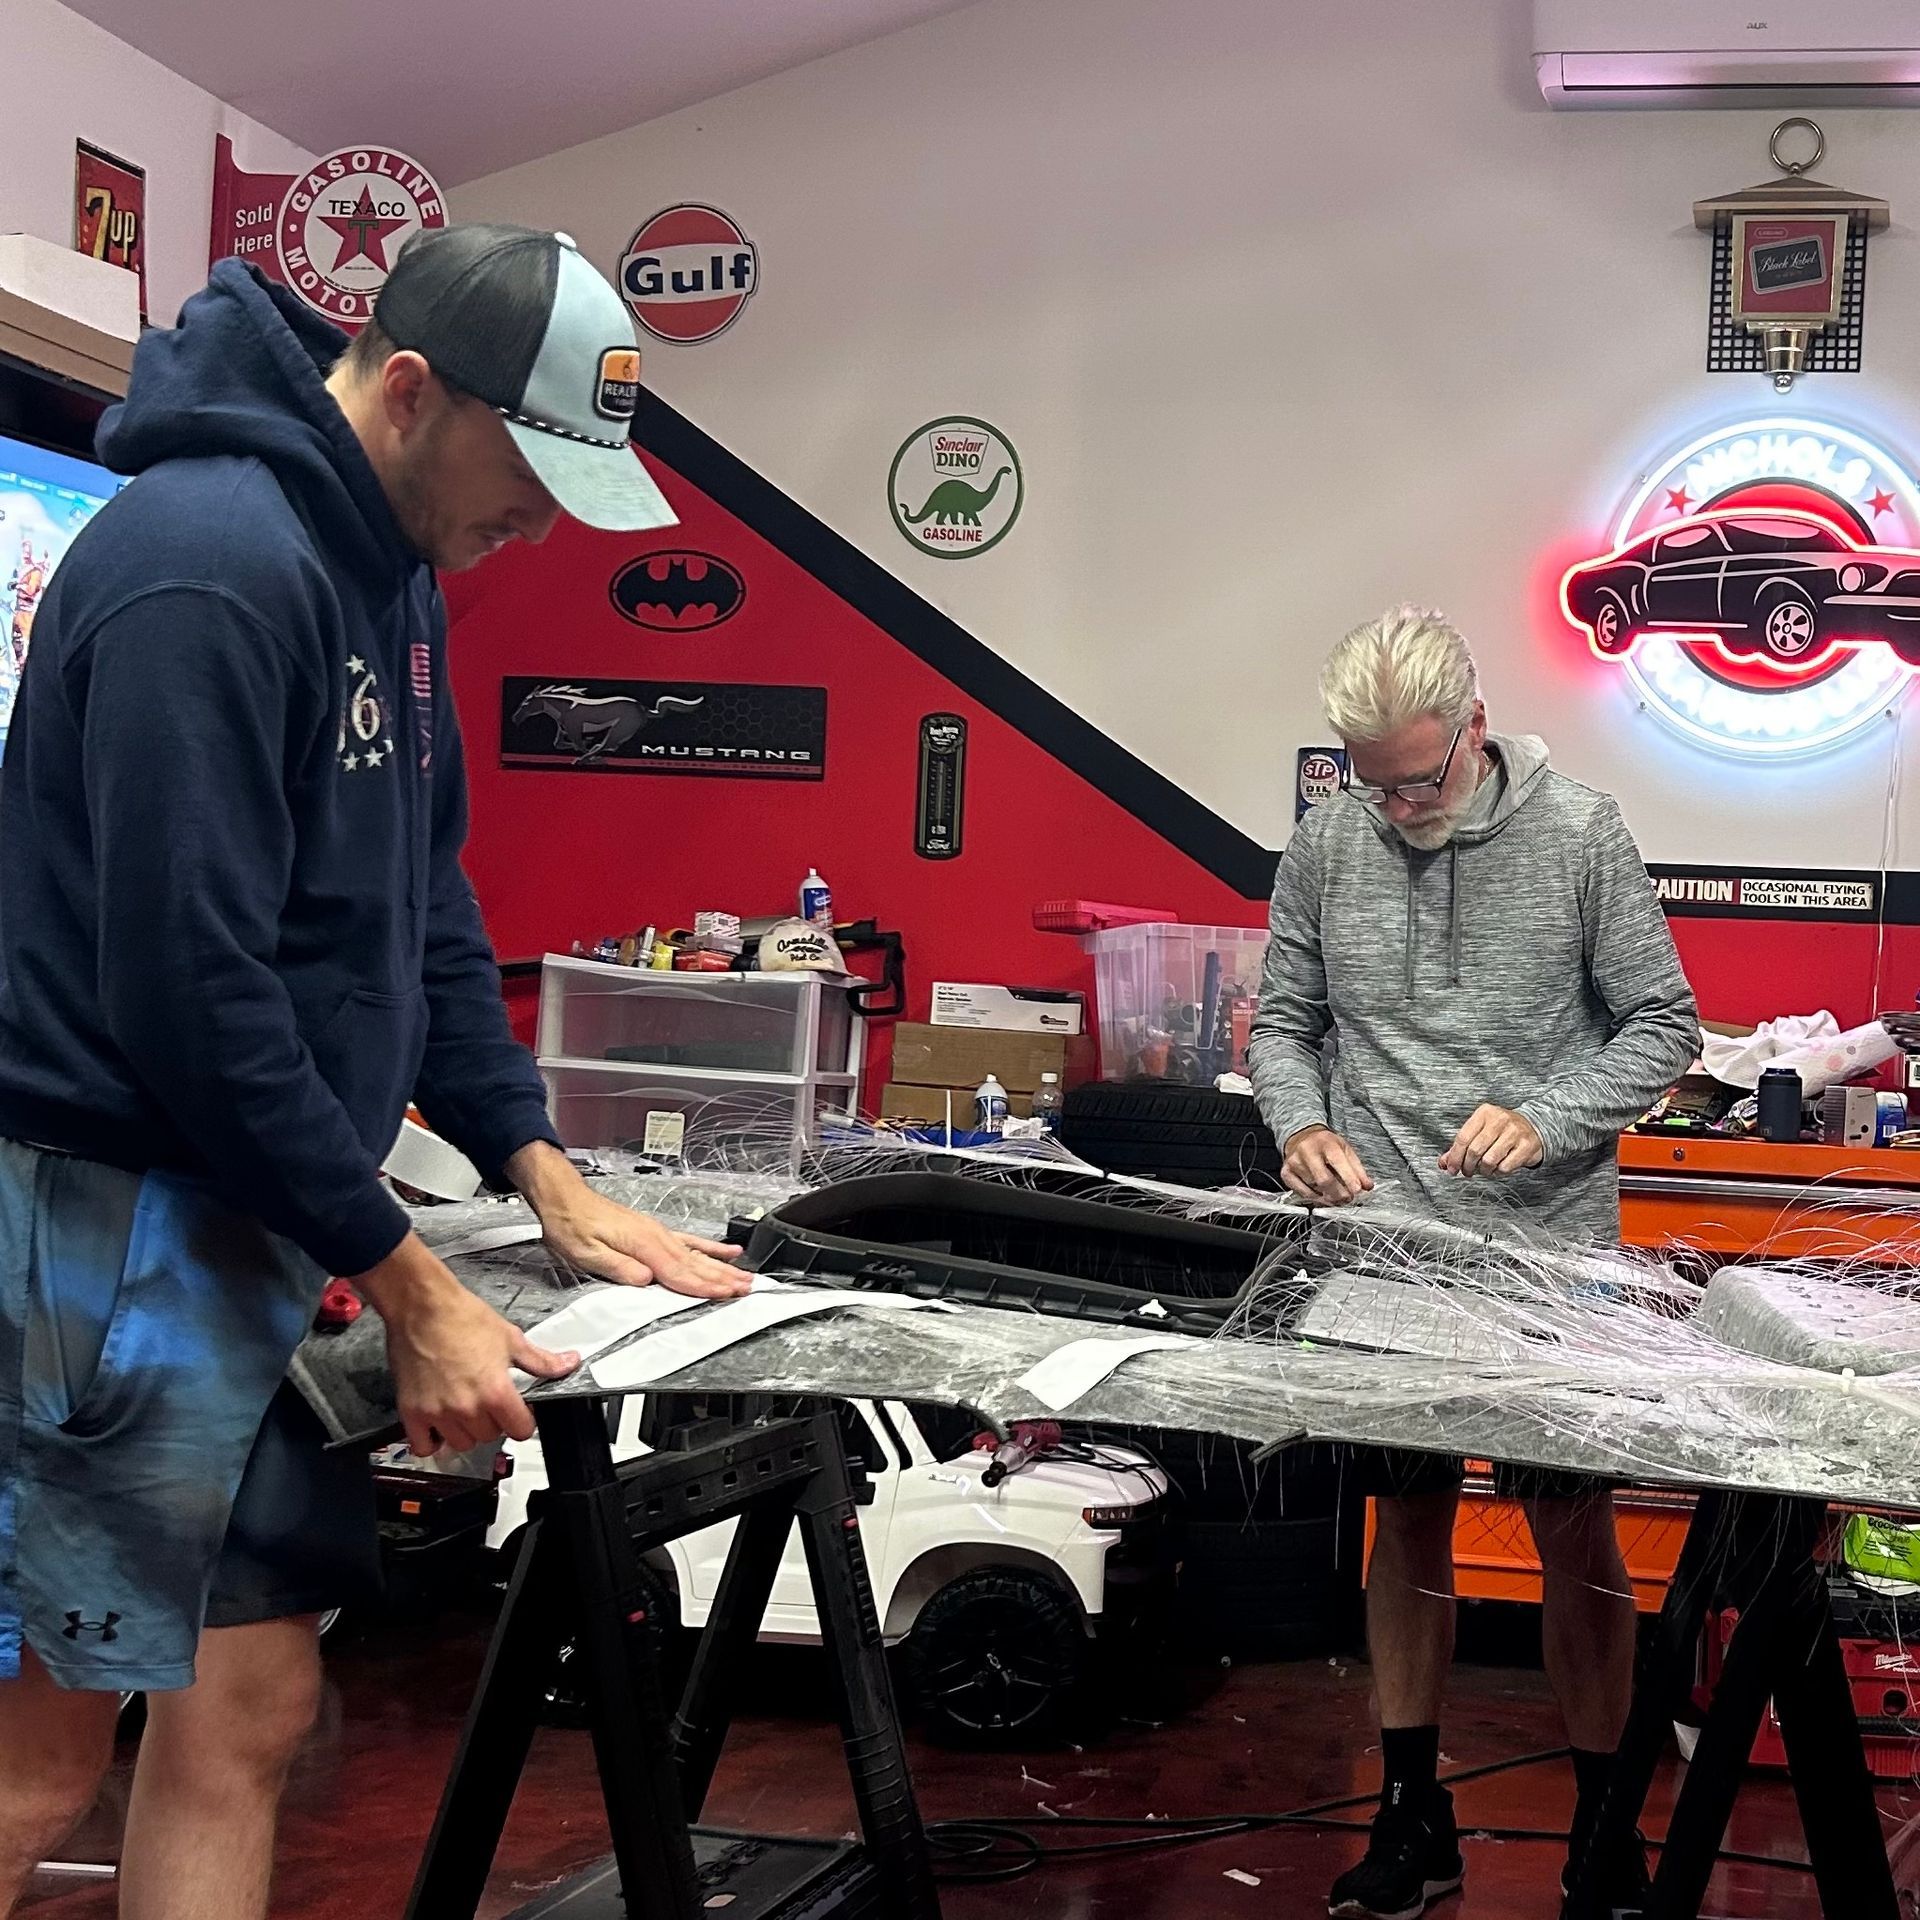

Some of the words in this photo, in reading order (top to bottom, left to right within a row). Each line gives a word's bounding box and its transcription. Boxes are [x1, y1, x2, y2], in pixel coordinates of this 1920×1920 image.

[291, 151, 441, 219] GASOLINE
[235, 203, 273, 229] Sold
[328, 199, 406, 217] TEXACO
[233, 234, 274, 256] Here
[1758, 255, 1789, 274] Black
[1791, 250, 1818, 270] Label
[624, 252, 752, 296] Gulf
[935, 436, 985, 453] Sinclair
[936, 452, 980, 468] DINO
[923, 527, 983, 543] GASOLINE
[641, 745, 811, 761] MUSTANG
[1304, 760, 1334, 777] STP
[1743, 881, 1818, 894] OCCASIONAL
[1823, 884, 1866, 895] FLYING
[1743, 893, 1780, 904] TOOLS
[1784, 894, 1798, 904] IN
[1802, 895, 1829, 906] THIS
[1833, 896, 1868, 908] AREA
